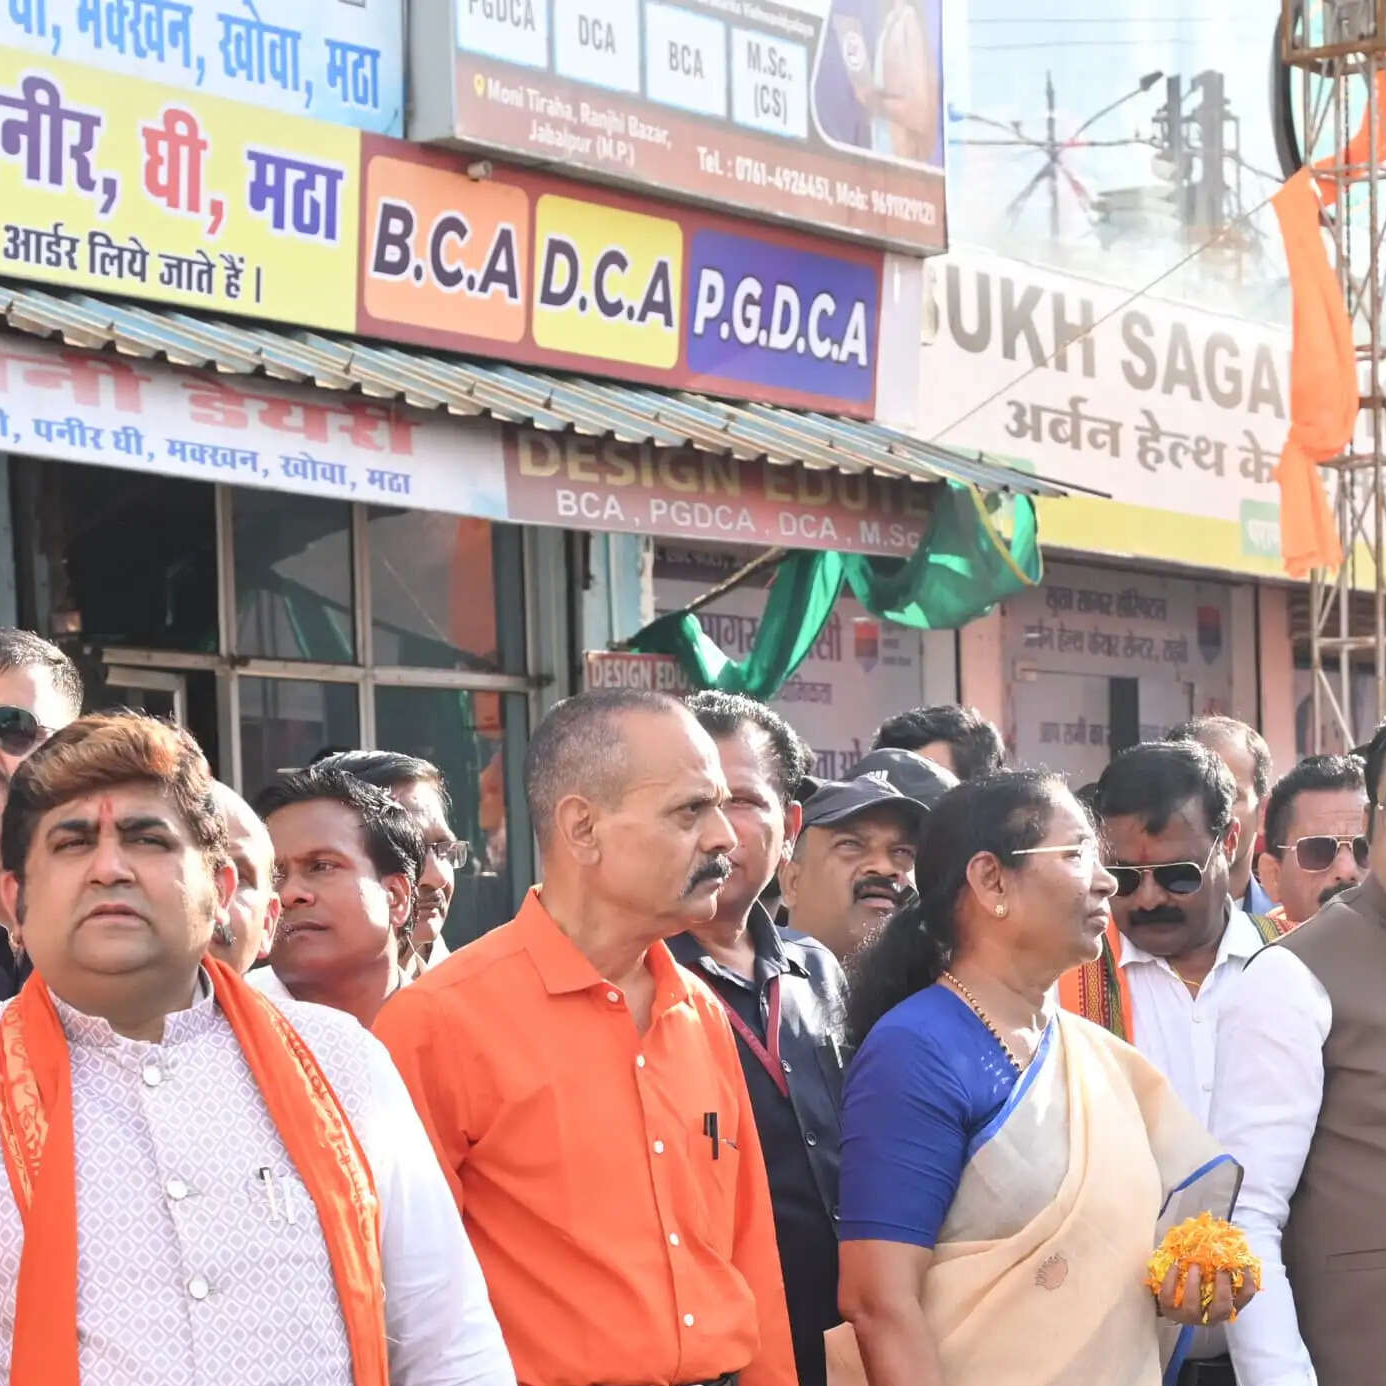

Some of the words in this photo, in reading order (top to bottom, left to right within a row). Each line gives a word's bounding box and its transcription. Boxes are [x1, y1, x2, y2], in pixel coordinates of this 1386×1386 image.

[577, 14, 617, 54] DCA
[668, 41, 705, 79] BCA
[746, 41, 793, 82] M.Sc.
[486, 77, 525, 107] Moni
[753, 84, 788, 126] (CS)
[142, 108, 224, 235] घी,
[247, 149, 344, 241] मठा
[3, 222, 80, 271] आर्डर
[87, 230, 150, 283] लिये
[158, 248, 216, 295] जाते
[373, 200, 520, 301] B.C.A
[538, 234, 676, 328] D.C.A
[691, 266, 870, 367] P.G.D.C.A
[1119, 309, 1286, 421] SAGA
[32, 417, 104, 450] पनीर
[1005, 395, 1121, 459] अर्बन
[1134, 407, 1228, 480] हेल्थ
[516, 428, 742, 498] DESIGN
[650, 499, 755, 533] PGDCA
[778, 513, 838, 542] DCA
[591, 658, 653, 689] DESIGN
[656, 660, 688, 690] EDU
